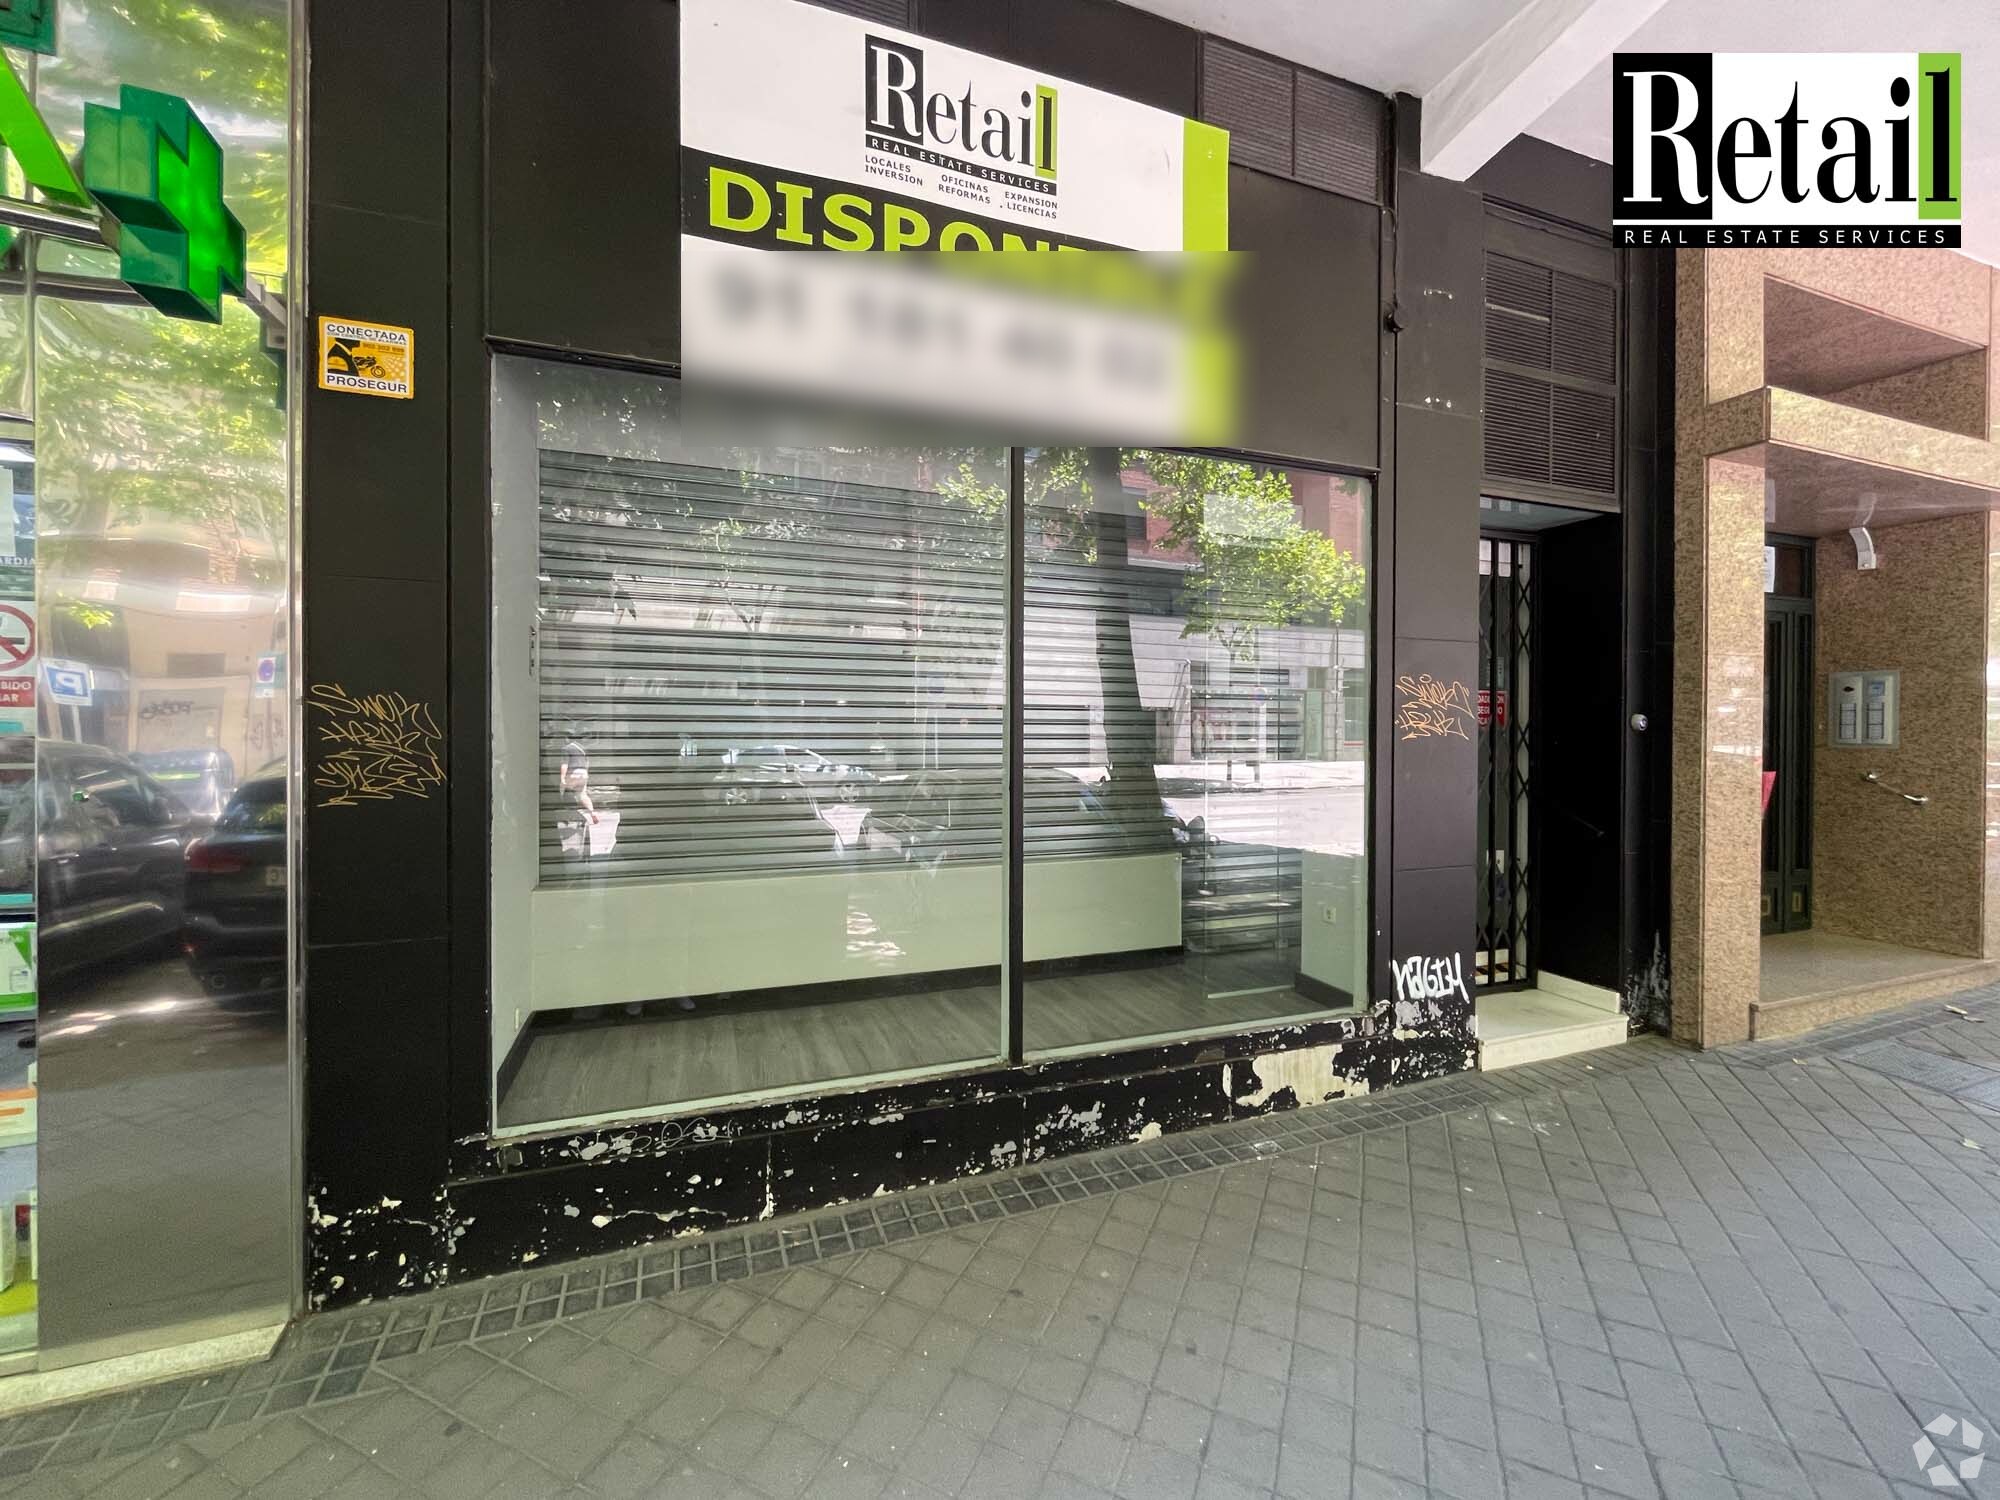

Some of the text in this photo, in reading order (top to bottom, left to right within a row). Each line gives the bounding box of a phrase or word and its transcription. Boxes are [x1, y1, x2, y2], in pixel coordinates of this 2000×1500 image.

[870, 45, 1055, 172] Retail
[865, 154, 1058, 209] LOCALES OFICINAS EXPANSION
[865, 165, 1057, 219] INVERSION REFORMAS LICENCIAS
[872, 138, 1050, 193] REAL ESTATE SERVICES
[327, 323, 407, 342] CONECTADA
[327, 375, 407, 393] PROSEGUR
